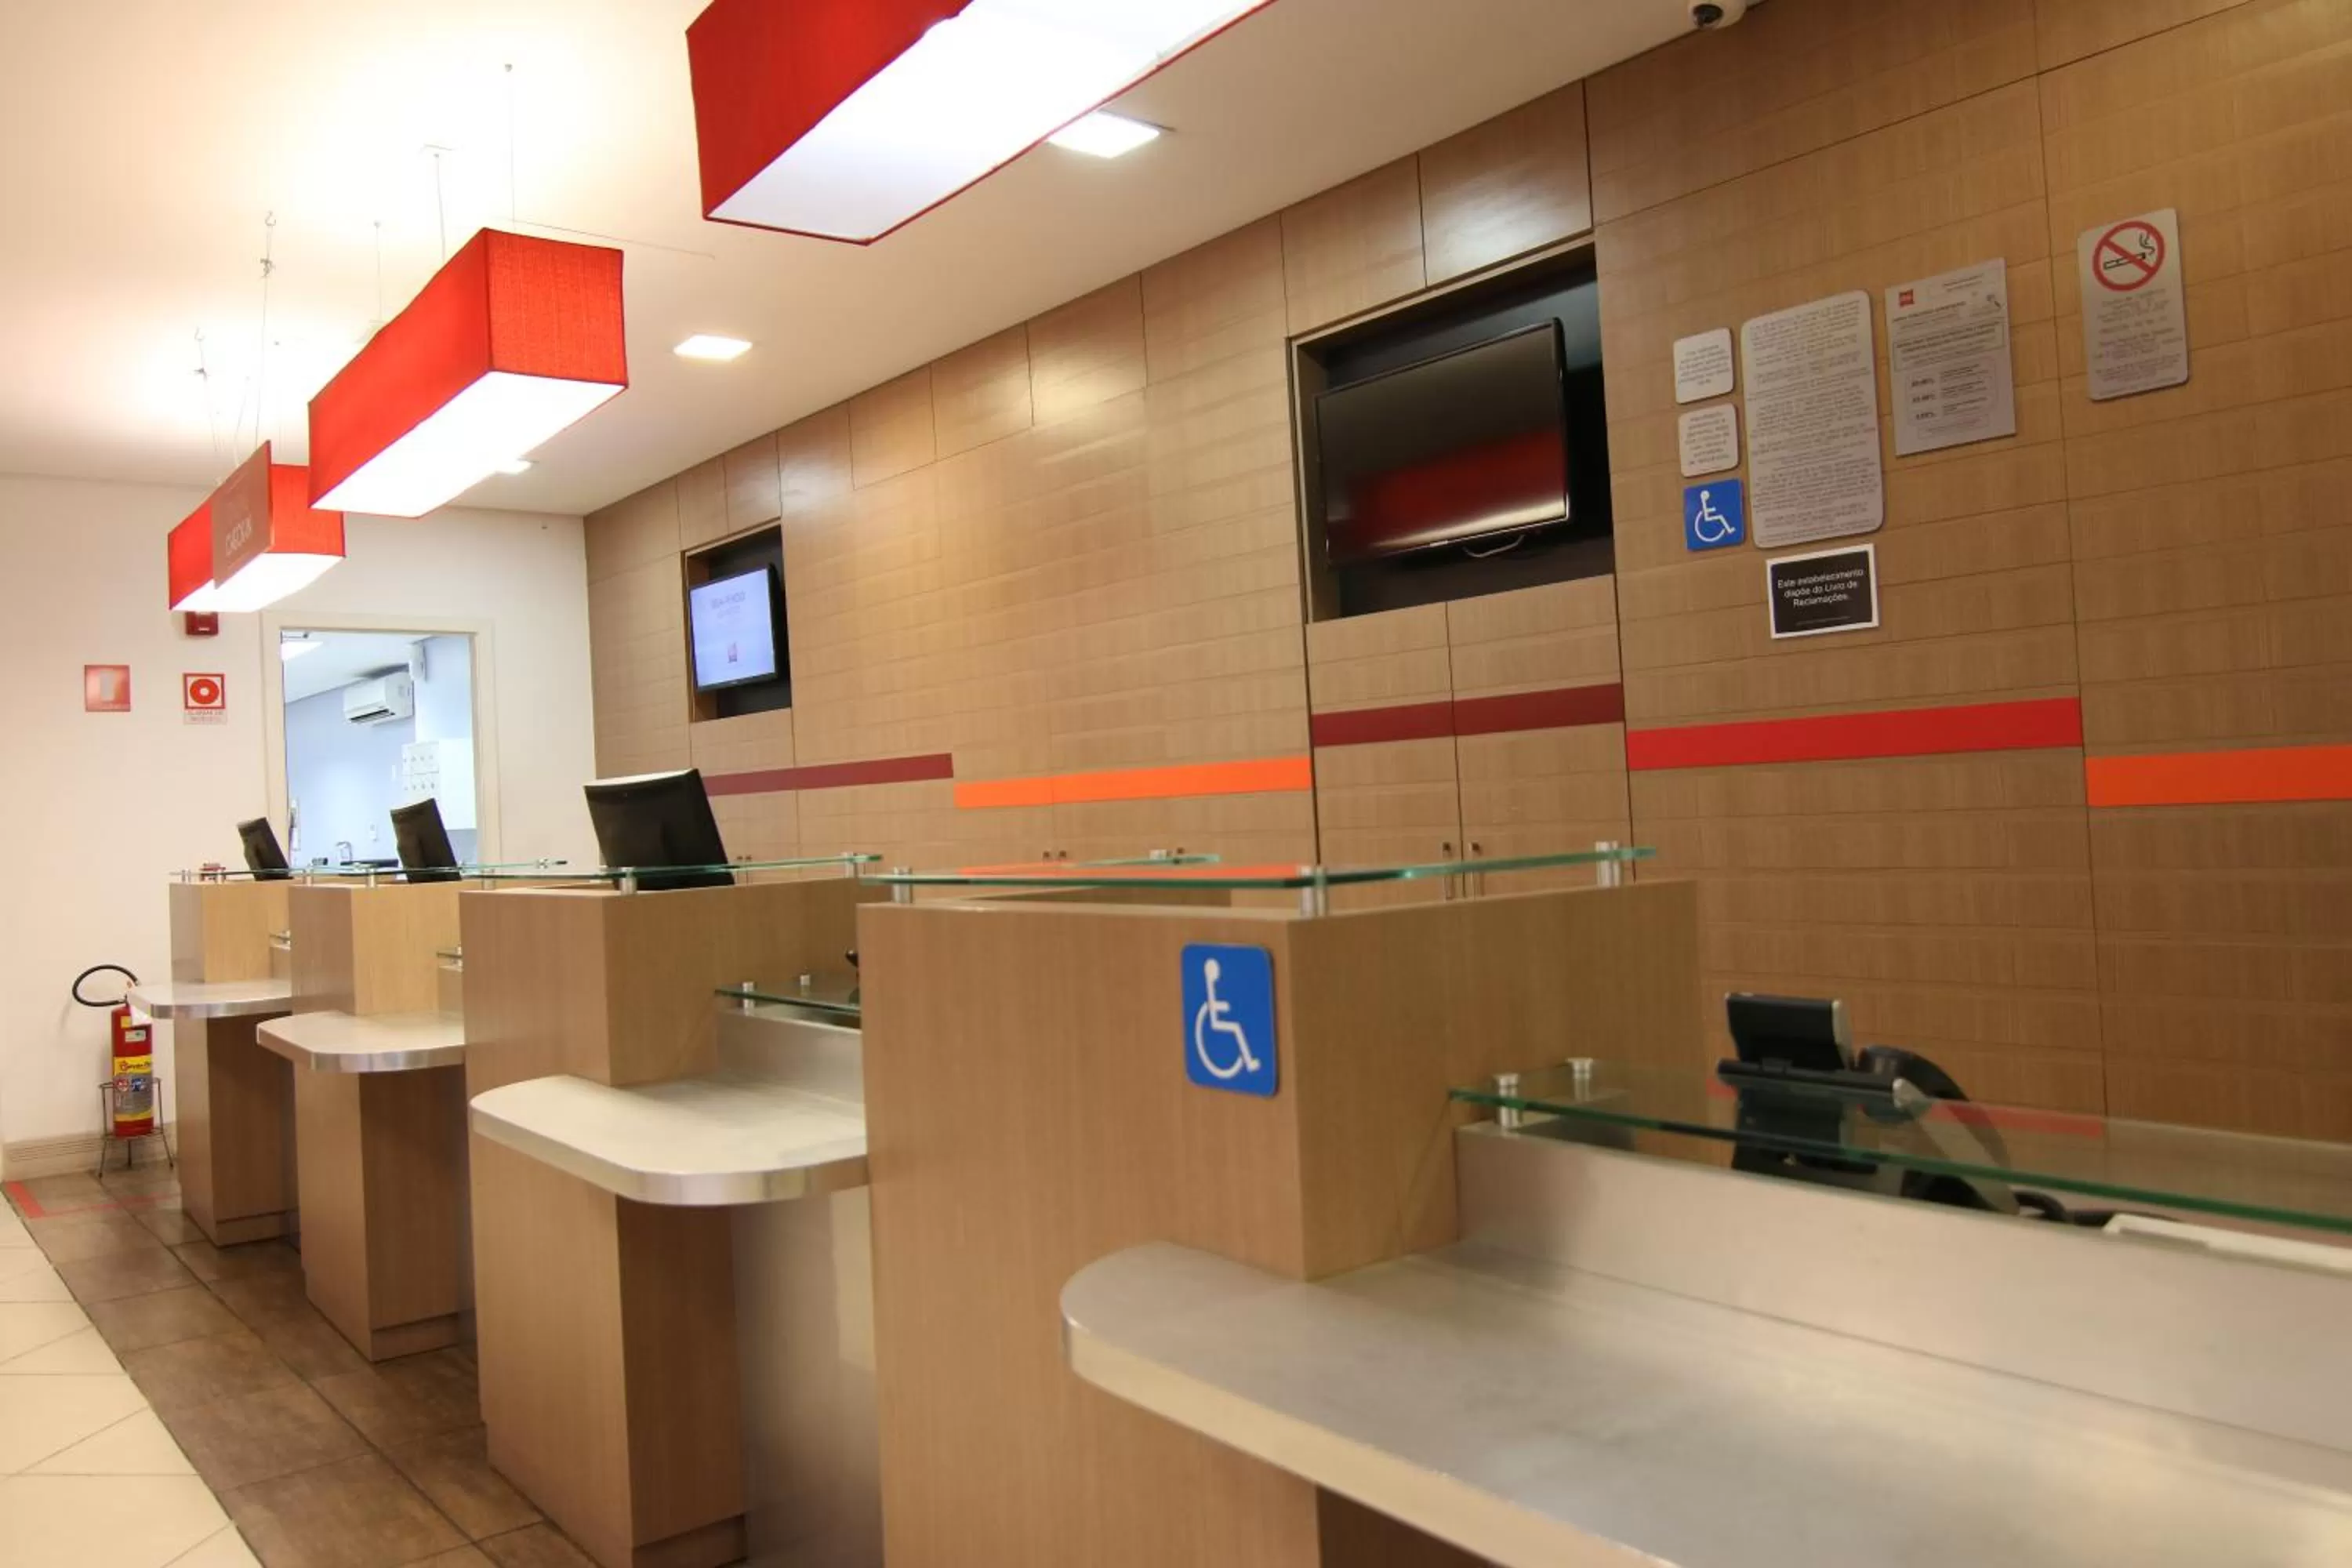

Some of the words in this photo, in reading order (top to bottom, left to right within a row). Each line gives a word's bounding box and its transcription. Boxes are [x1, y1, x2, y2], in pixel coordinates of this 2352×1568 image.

[1777, 579, 1796, 589] Este
[1813, 585, 1824, 593] do
[1847, 580, 1858, 589] de
